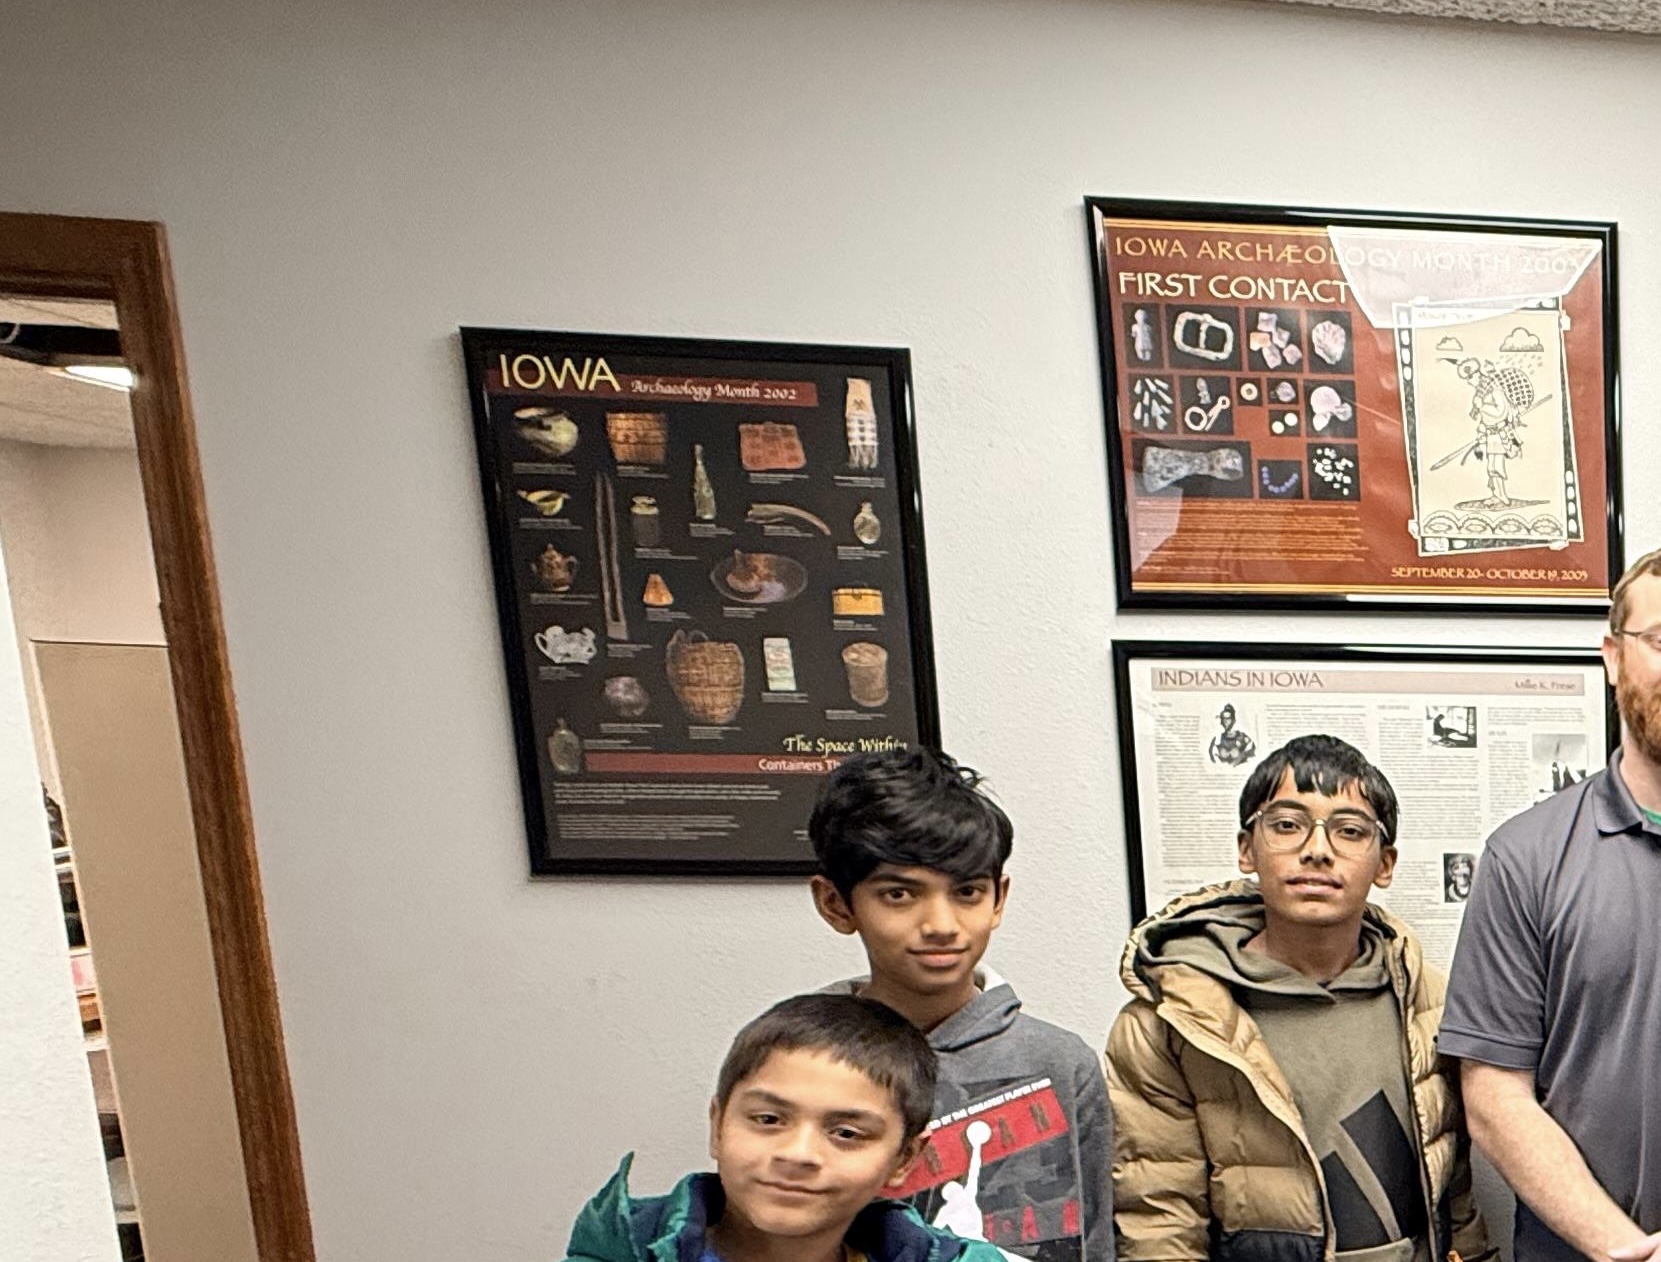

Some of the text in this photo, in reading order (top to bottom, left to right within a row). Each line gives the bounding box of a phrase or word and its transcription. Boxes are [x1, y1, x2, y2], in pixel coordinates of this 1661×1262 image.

[1116, 237, 1188, 259] IOWA
[1413, 250, 1512, 272] MONTH
[1119, 271, 1351, 304] FIRST CONTACT
[499, 353, 799, 402] IOWA Archaeology Month 2002
[1391, 567, 1466, 579] SEPTEMBER
[1486, 567, 1546, 580] OCTOBER
[1158, 670, 1324, 688] INDIANS IN IOWA
[783, 734, 813, 752] The
[816, 737, 855, 758] Space
[758, 758, 824, 772] Containers
